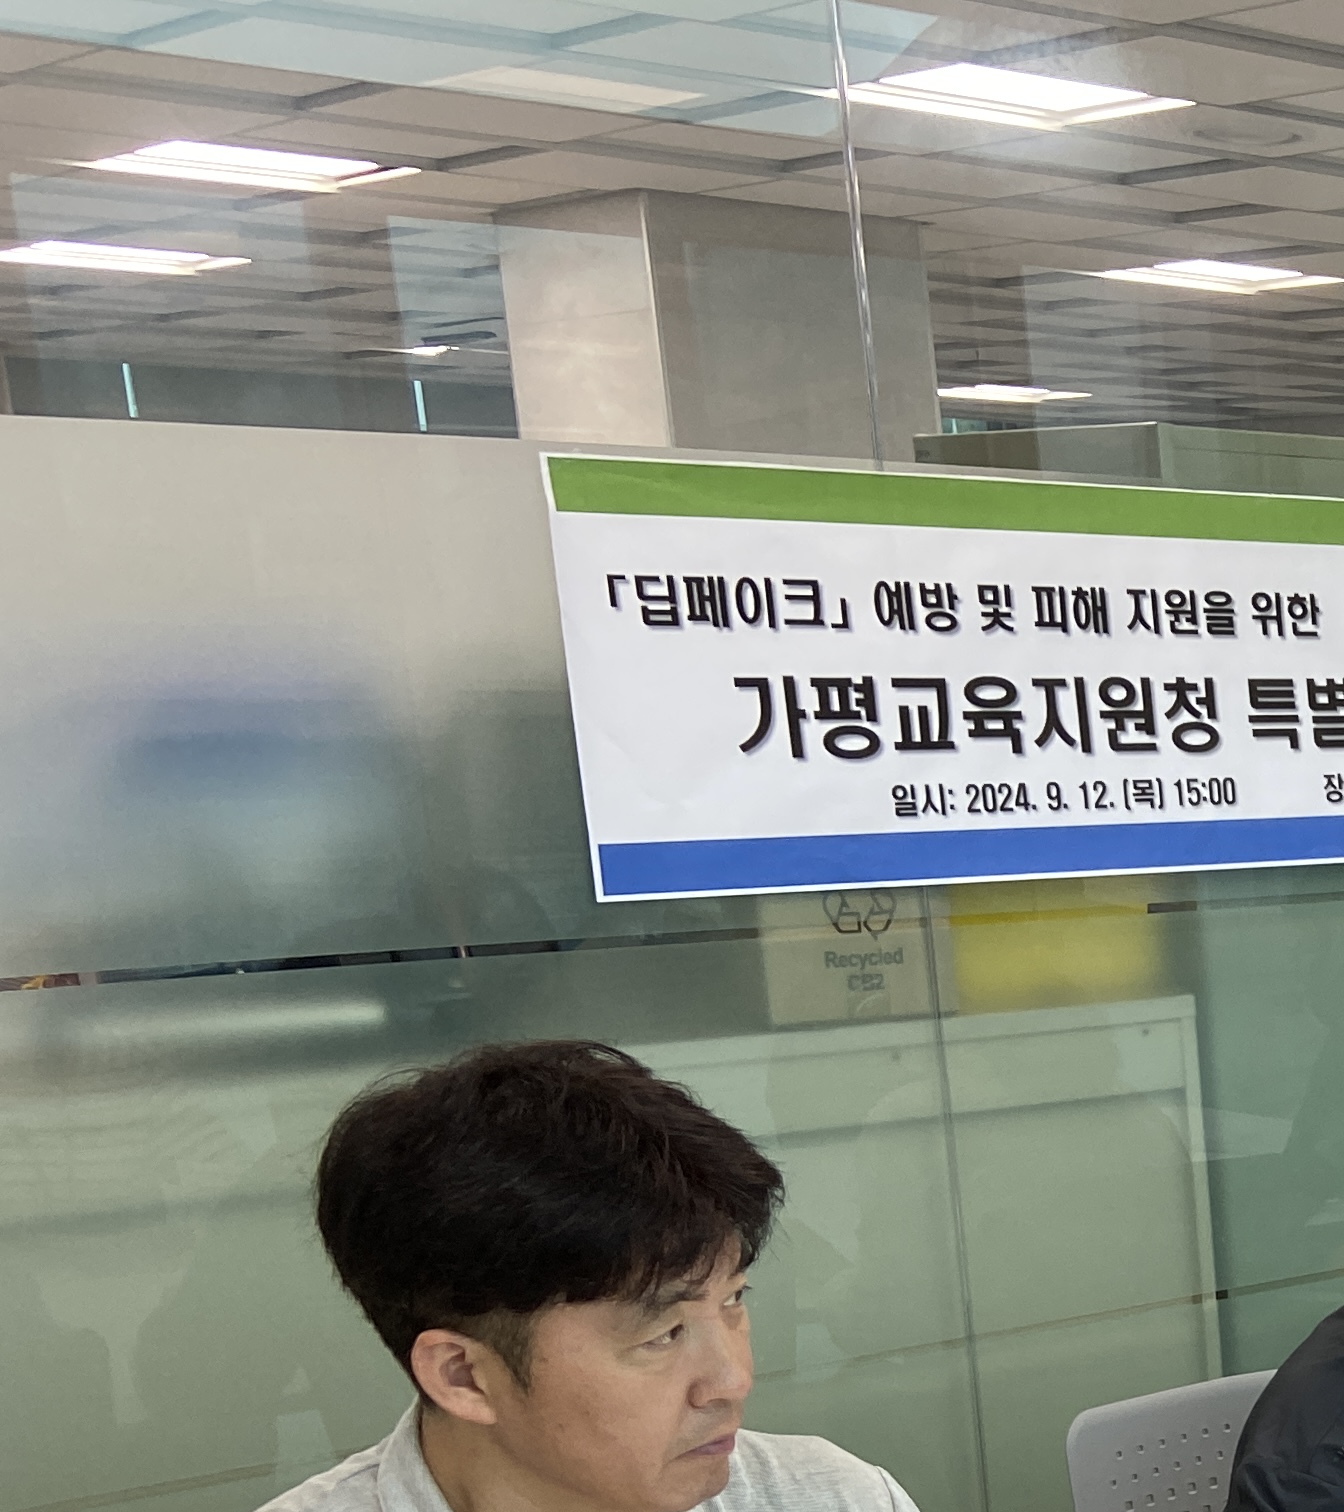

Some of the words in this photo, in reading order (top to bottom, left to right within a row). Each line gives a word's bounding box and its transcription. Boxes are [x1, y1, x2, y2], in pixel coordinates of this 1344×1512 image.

[874, 580, 958, 632] 예방
[977, 584, 1015, 633] 및
[1031, 585, 1109, 635] 피해
[1126, 588, 1238, 636] 지원을
[1251, 592, 1320, 638] 위한
[733, 675, 1220, 759] 가평교육지원청
[891, 783, 955, 816] 일시:
[966, 783, 1037, 813] 2024.
[1046, 781, 1069, 811] 9.
[1079, 780, 1115, 809] 12.
[1174, 776, 1236, 806] 15:00
[824, 947, 904, 970] Recycled
